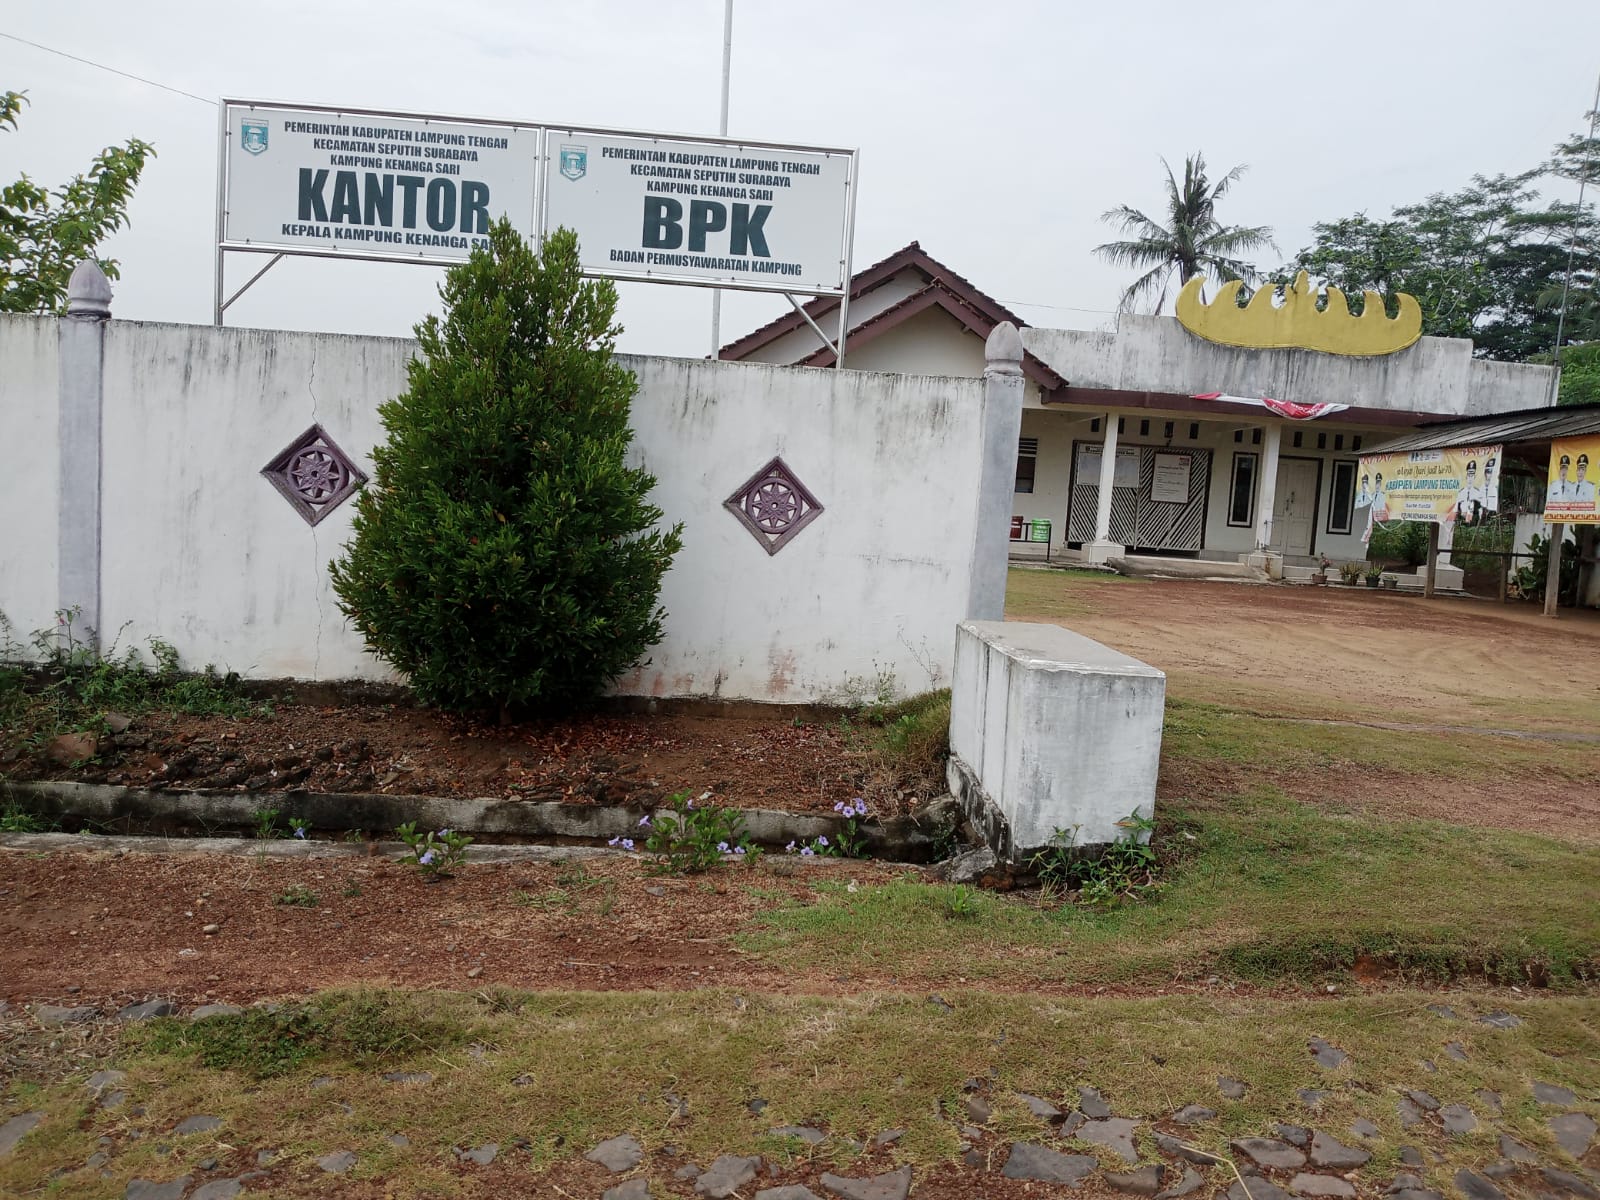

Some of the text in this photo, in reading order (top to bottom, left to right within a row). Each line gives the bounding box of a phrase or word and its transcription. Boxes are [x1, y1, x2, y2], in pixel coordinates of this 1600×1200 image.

[284, 121, 508, 149] PEMERINTAH KABUPATEN LAMPUNG TENGAH
[313, 138, 478, 162] KECAMATAN SEPUTIH SURABAYA
[602, 147, 820, 175] PEMERINTAH KABUPATEN LAMPUNG TENGAH
[330, 154, 460, 175] KAMPUNG KENANGA SARI
[630, 164, 791, 188] KECAMATAN SEPUTIH SURABAYA
[298, 168, 490, 235] KANTOR
[647, 180, 773, 201] KAMPUNG KENANGA SARI
[282, 223, 496, 251] KEPALA KAMPUNG KENANGA SA
[642, 195, 773, 258] BPK
[610, 249, 802, 276] BADAN PERMUSYAWARATAN KAMPUNG
